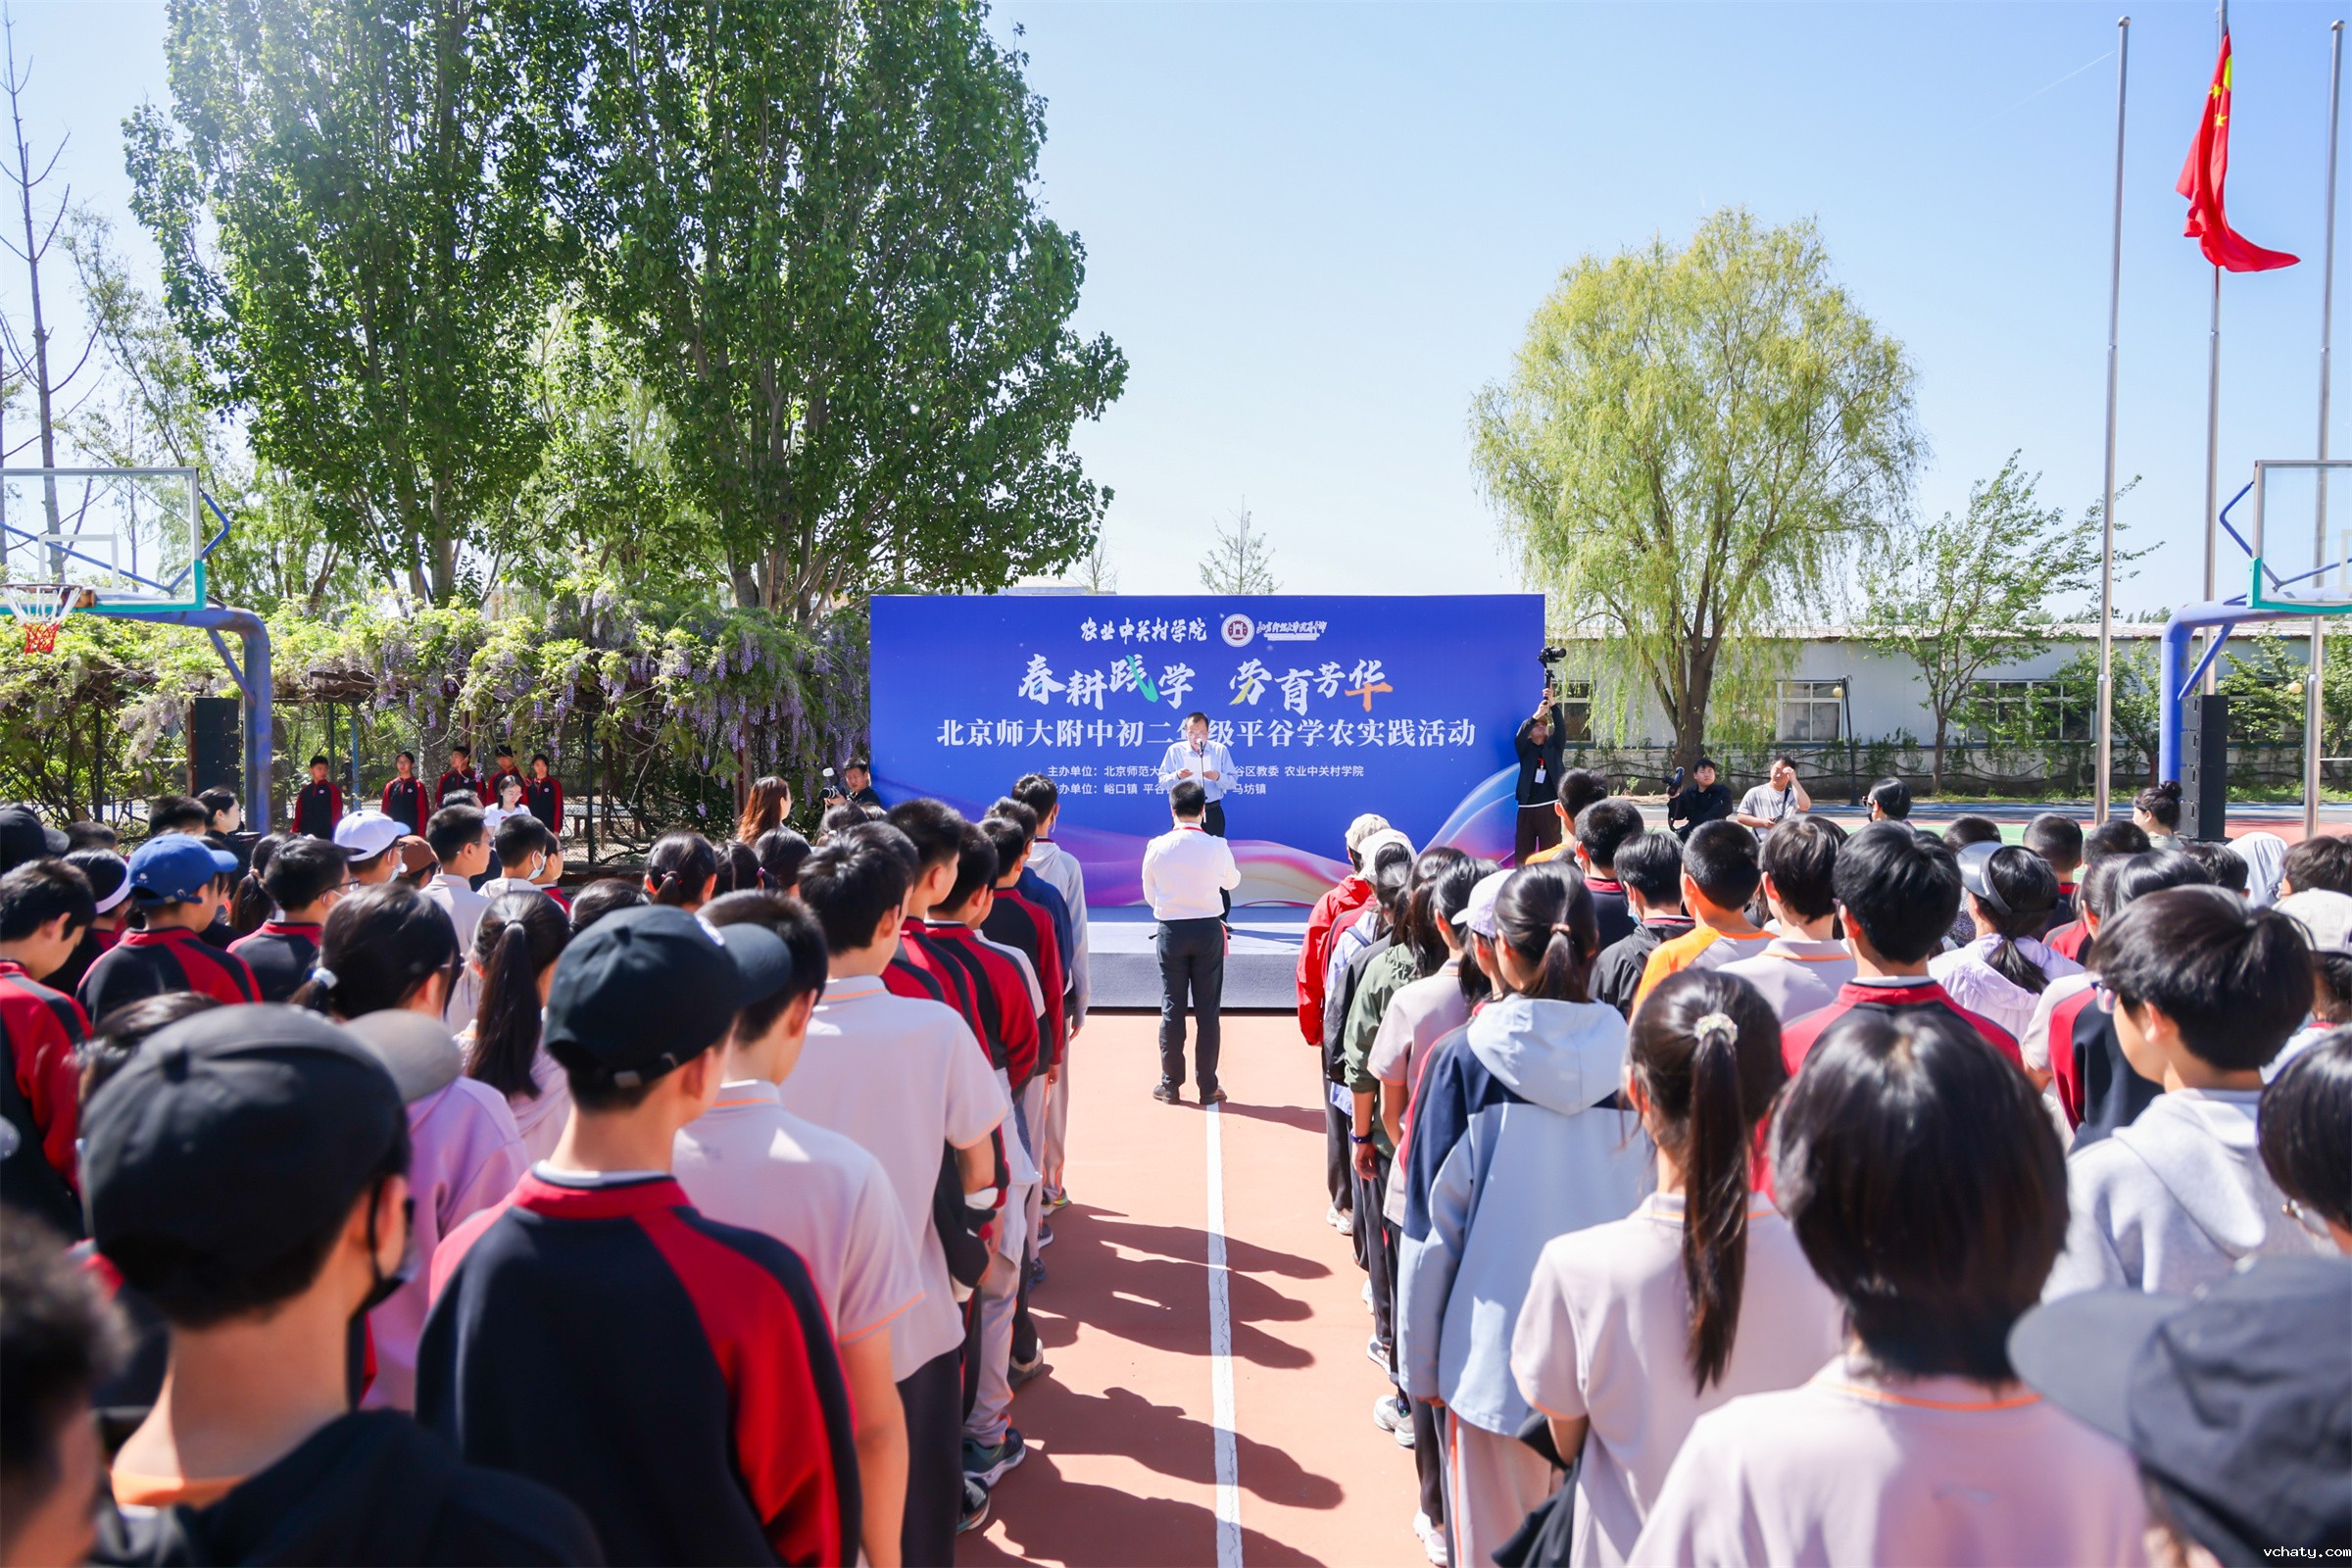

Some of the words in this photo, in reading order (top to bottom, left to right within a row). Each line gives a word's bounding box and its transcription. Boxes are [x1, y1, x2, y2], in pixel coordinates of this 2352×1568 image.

[1080, 616, 1207, 645] 农业中关村学院
[1017, 653, 1196, 711] 春耕践学
[1228, 658, 1394, 716] 劳育芳华
[1284, 764, 1364, 777] 农业中关村学院
[1056, 783, 1138, 795] 办单位：峪口镇
[1233, 783, 1266, 795] 马坊镇
